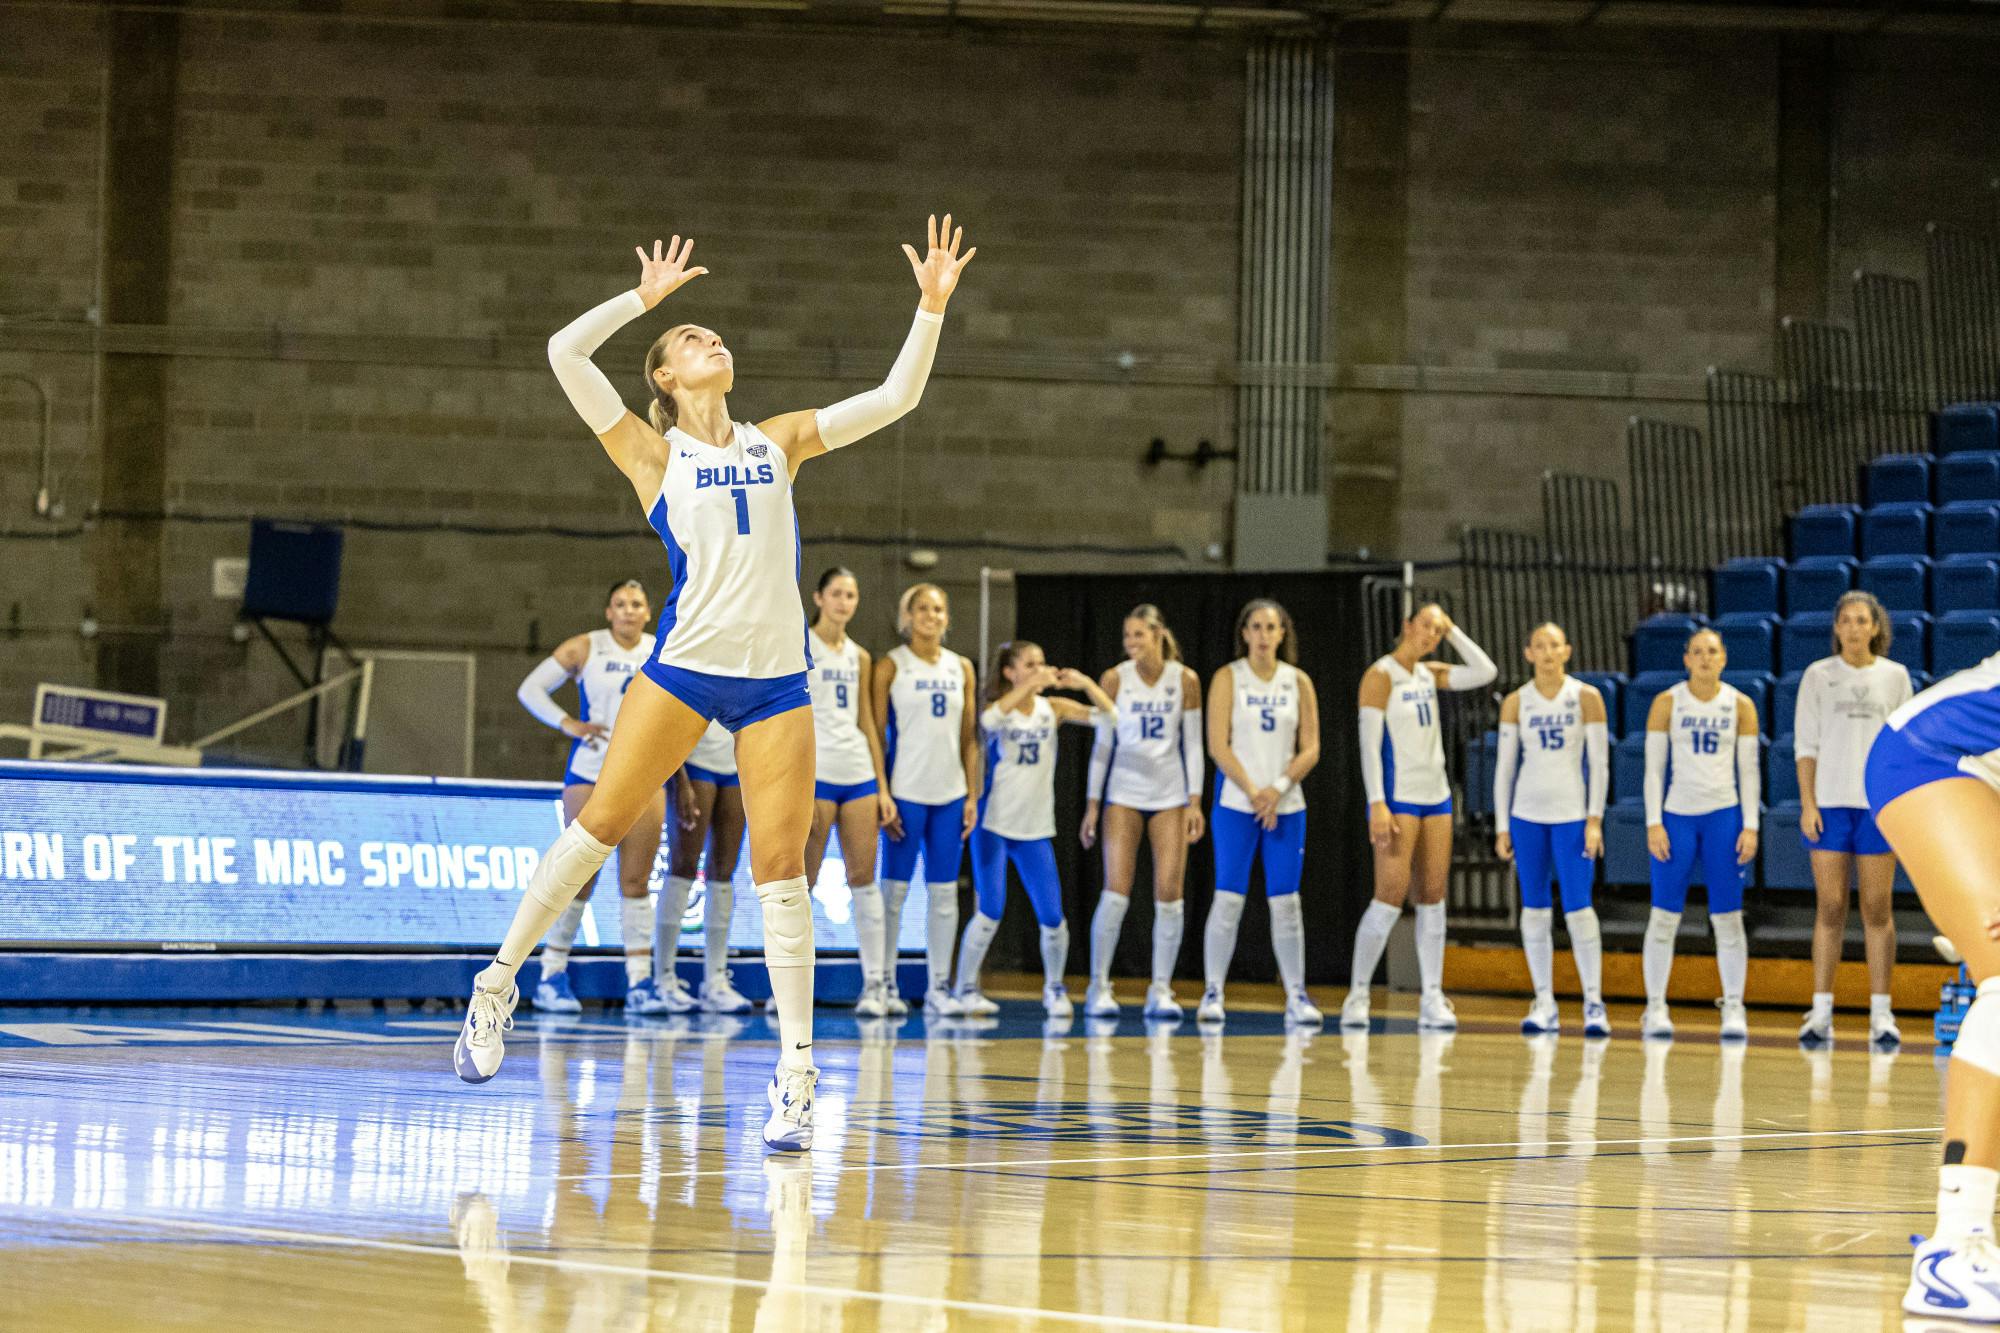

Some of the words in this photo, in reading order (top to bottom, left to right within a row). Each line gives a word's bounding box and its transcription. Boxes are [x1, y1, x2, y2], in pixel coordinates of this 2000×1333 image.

[695, 463, 774, 489] BULLS
[730, 488, 751, 535] 1
[836, 684, 848, 708] 9
[931, 693, 946, 717] 8
[1261, 708, 1276, 732] 5
[1416, 702, 1431, 727] 11
[1529, 713, 1575, 728] BULLS
[1681, 716, 1730, 729] BULLS
[1140, 716, 1164, 740] 12
[1539, 729, 1565, 750] 15
[1018, 742, 1040, 765] 13
[1691, 731, 1720, 754] 16
[0, 830, 65, 881] RN
[82, 834, 138, 882] OF
[152, 836, 240, 885] THE
[253, 838, 347, 886] MAC
[359, 841, 540, 890] SPONSOR
